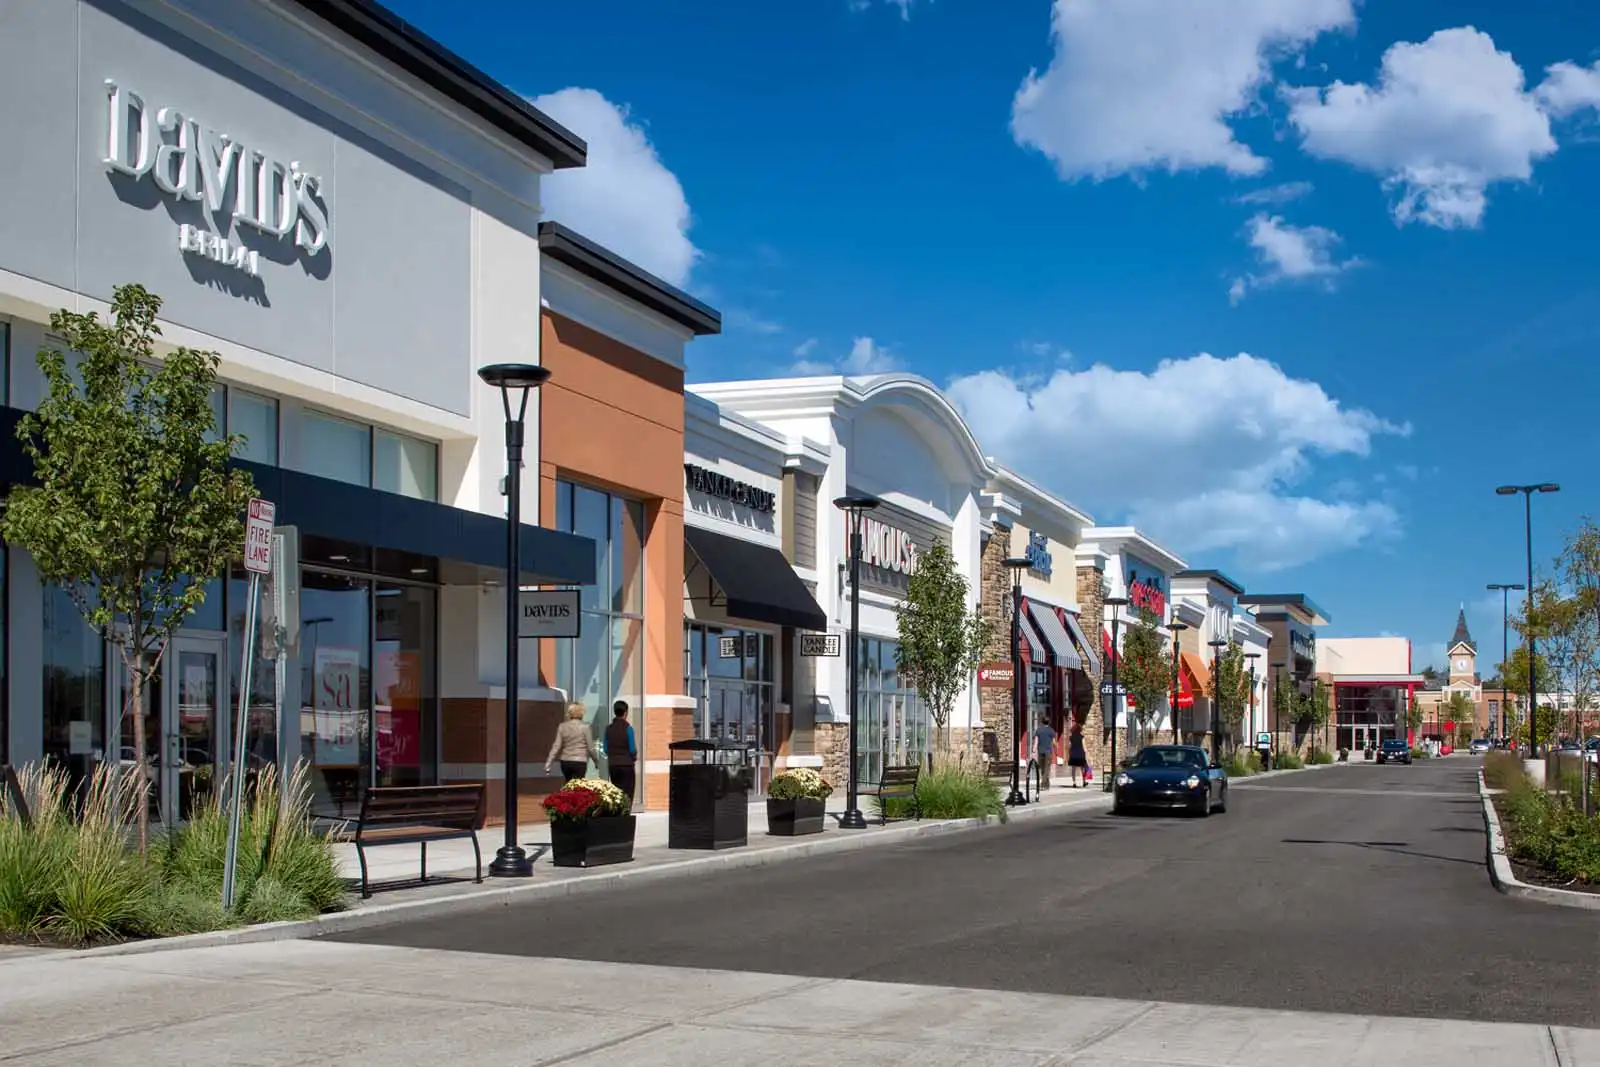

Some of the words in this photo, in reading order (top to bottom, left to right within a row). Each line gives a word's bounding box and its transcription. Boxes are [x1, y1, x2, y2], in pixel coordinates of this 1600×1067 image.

[250, 526, 270, 545] FIRE
[248, 544, 269, 563] LANE
[804, 637, 837, 646] YANKEE
[804, 646, 837, 654] CANDLE
